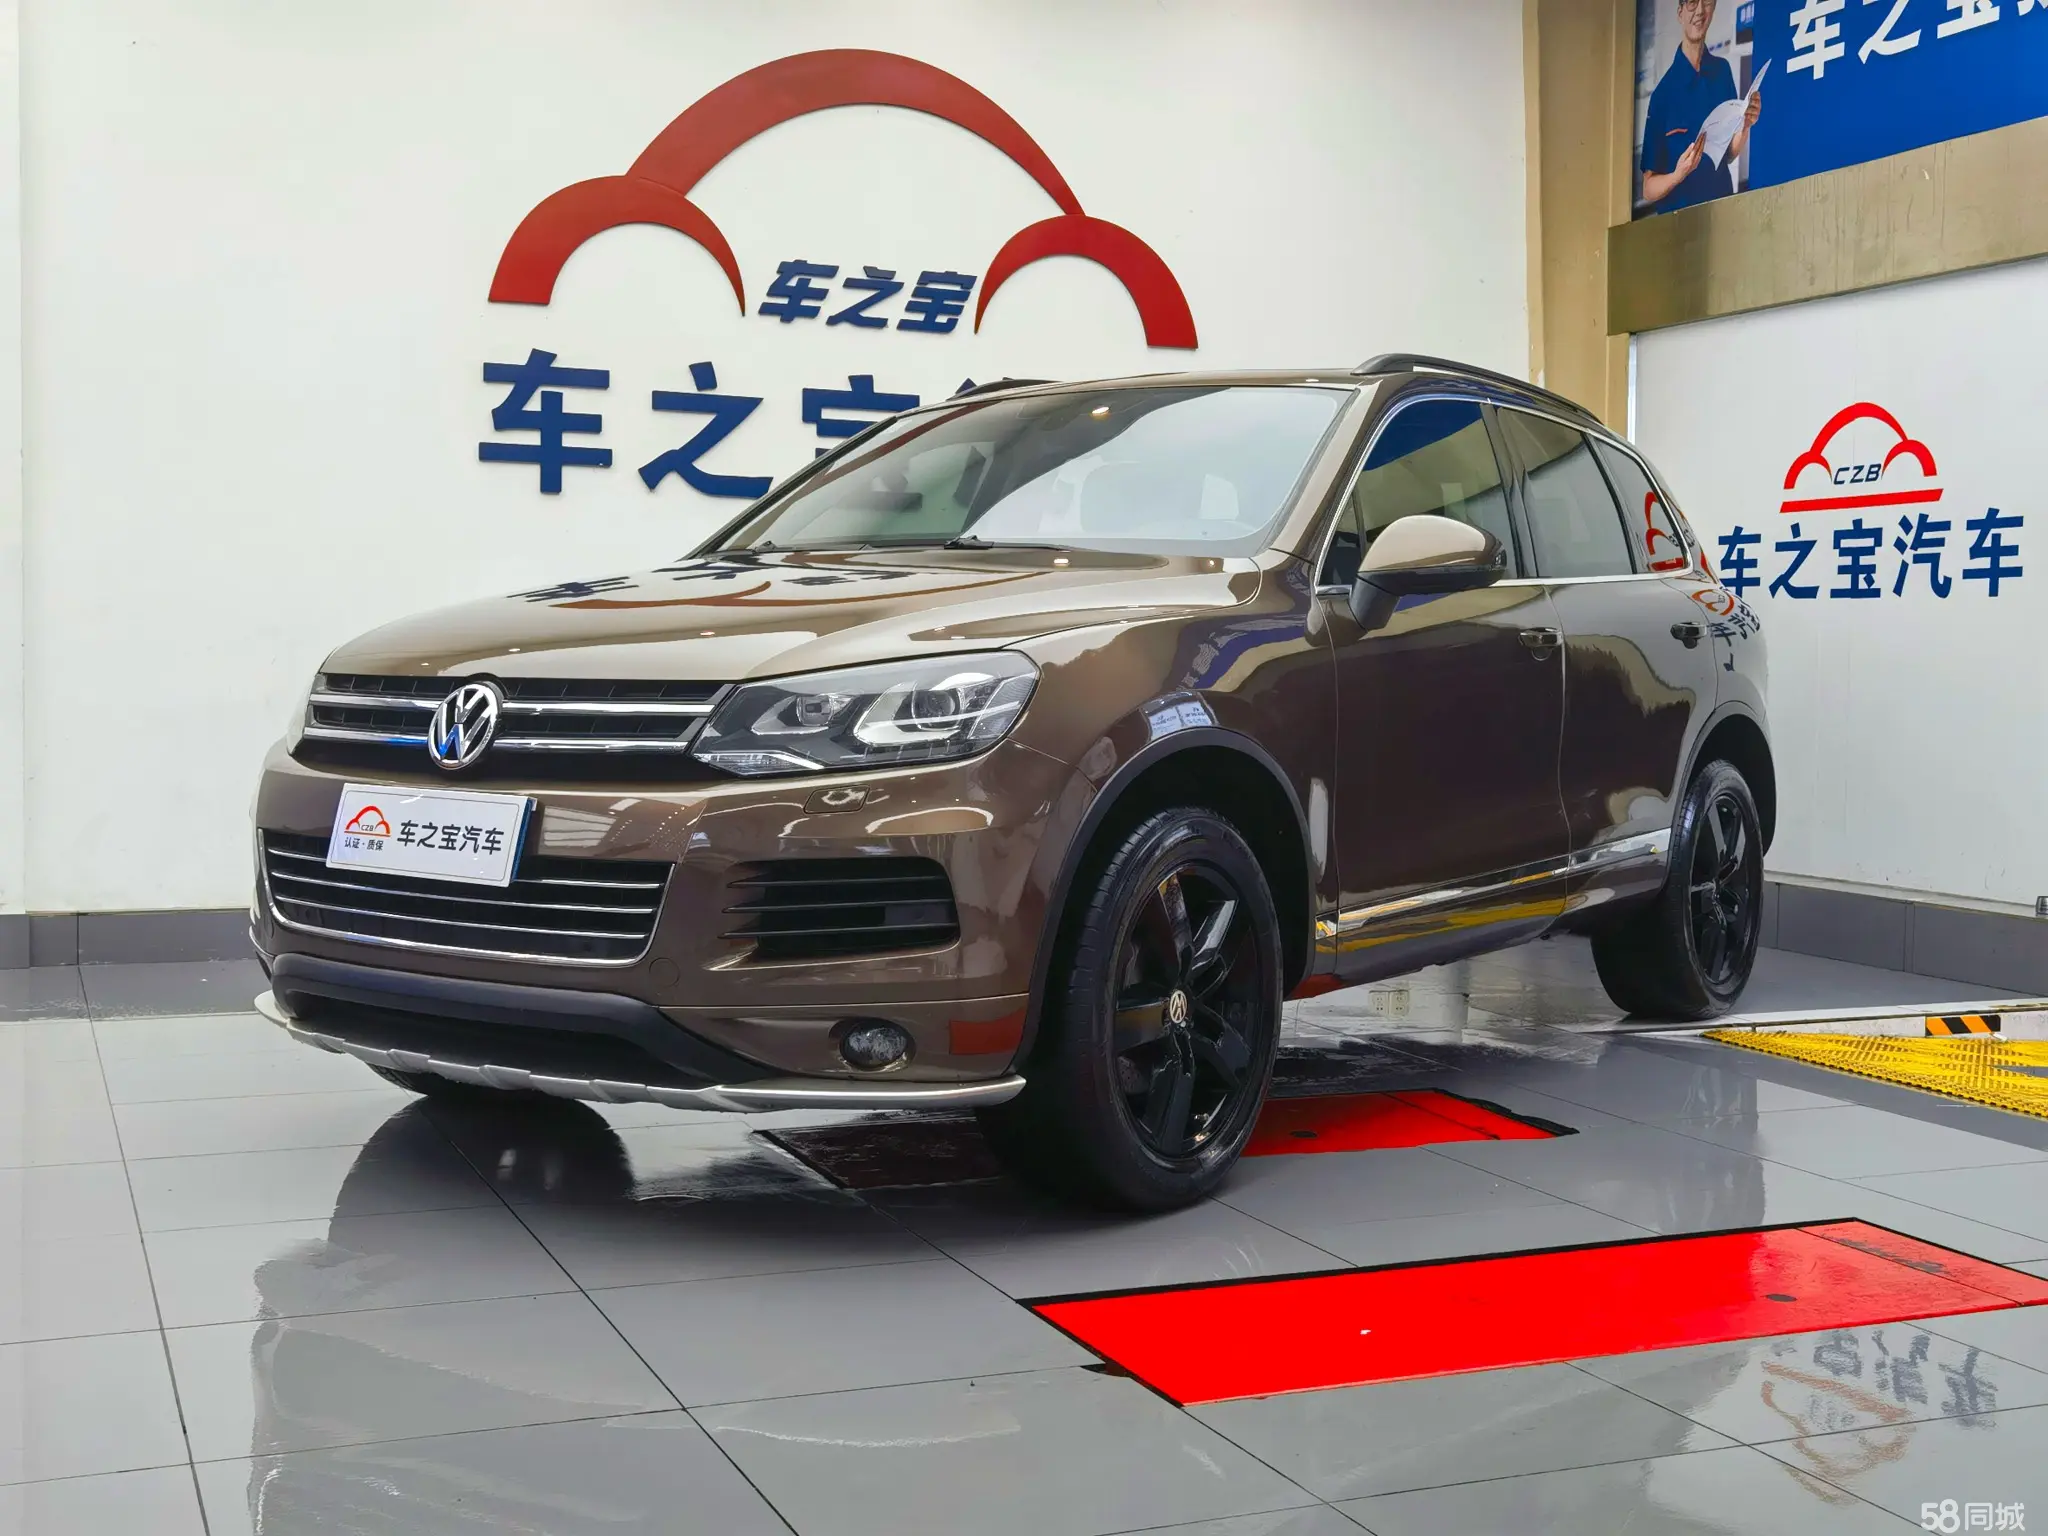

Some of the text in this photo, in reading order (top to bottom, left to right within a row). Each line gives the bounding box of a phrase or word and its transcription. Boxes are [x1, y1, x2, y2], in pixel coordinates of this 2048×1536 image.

[758, 259, 977, 334] 车之宝
[1833, 463, 1882, 485] CZB
[1718, 507, 2024, 599] 车之宝汽车
[360, 824, 374, 832] CZB
[397, 819, 504, 855] 车之宝汽车
